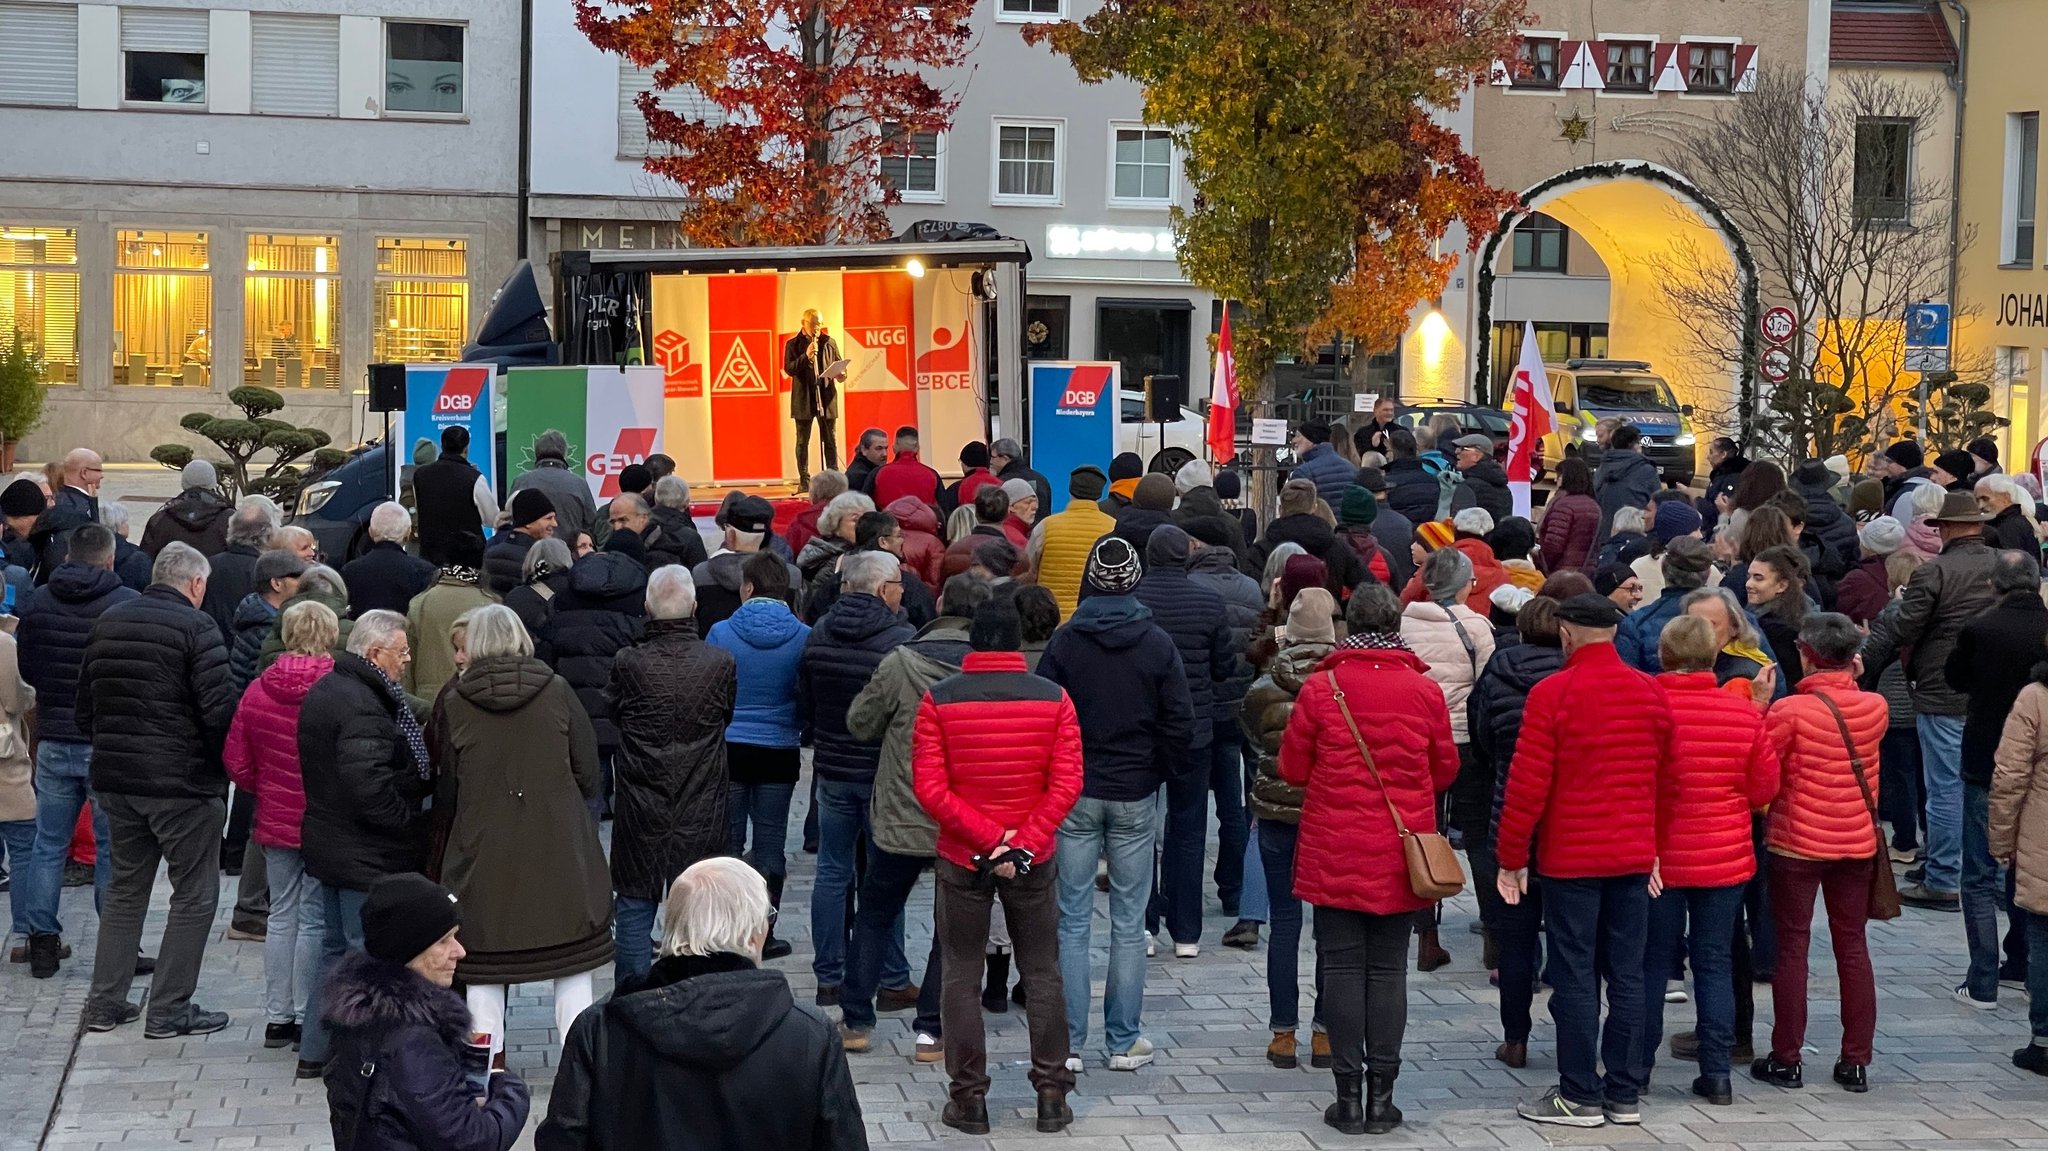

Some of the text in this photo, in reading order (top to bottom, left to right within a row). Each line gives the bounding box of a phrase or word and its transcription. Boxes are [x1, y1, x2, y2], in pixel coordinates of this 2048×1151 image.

[865, 329, 906, 346] NGG
[932, 374, 970, 390] BCE
[440, 395, 472, 410] DGB
[1065, 390, 1096, 405] DGB
[1055, 408, 1095, 418] Niederbayern
